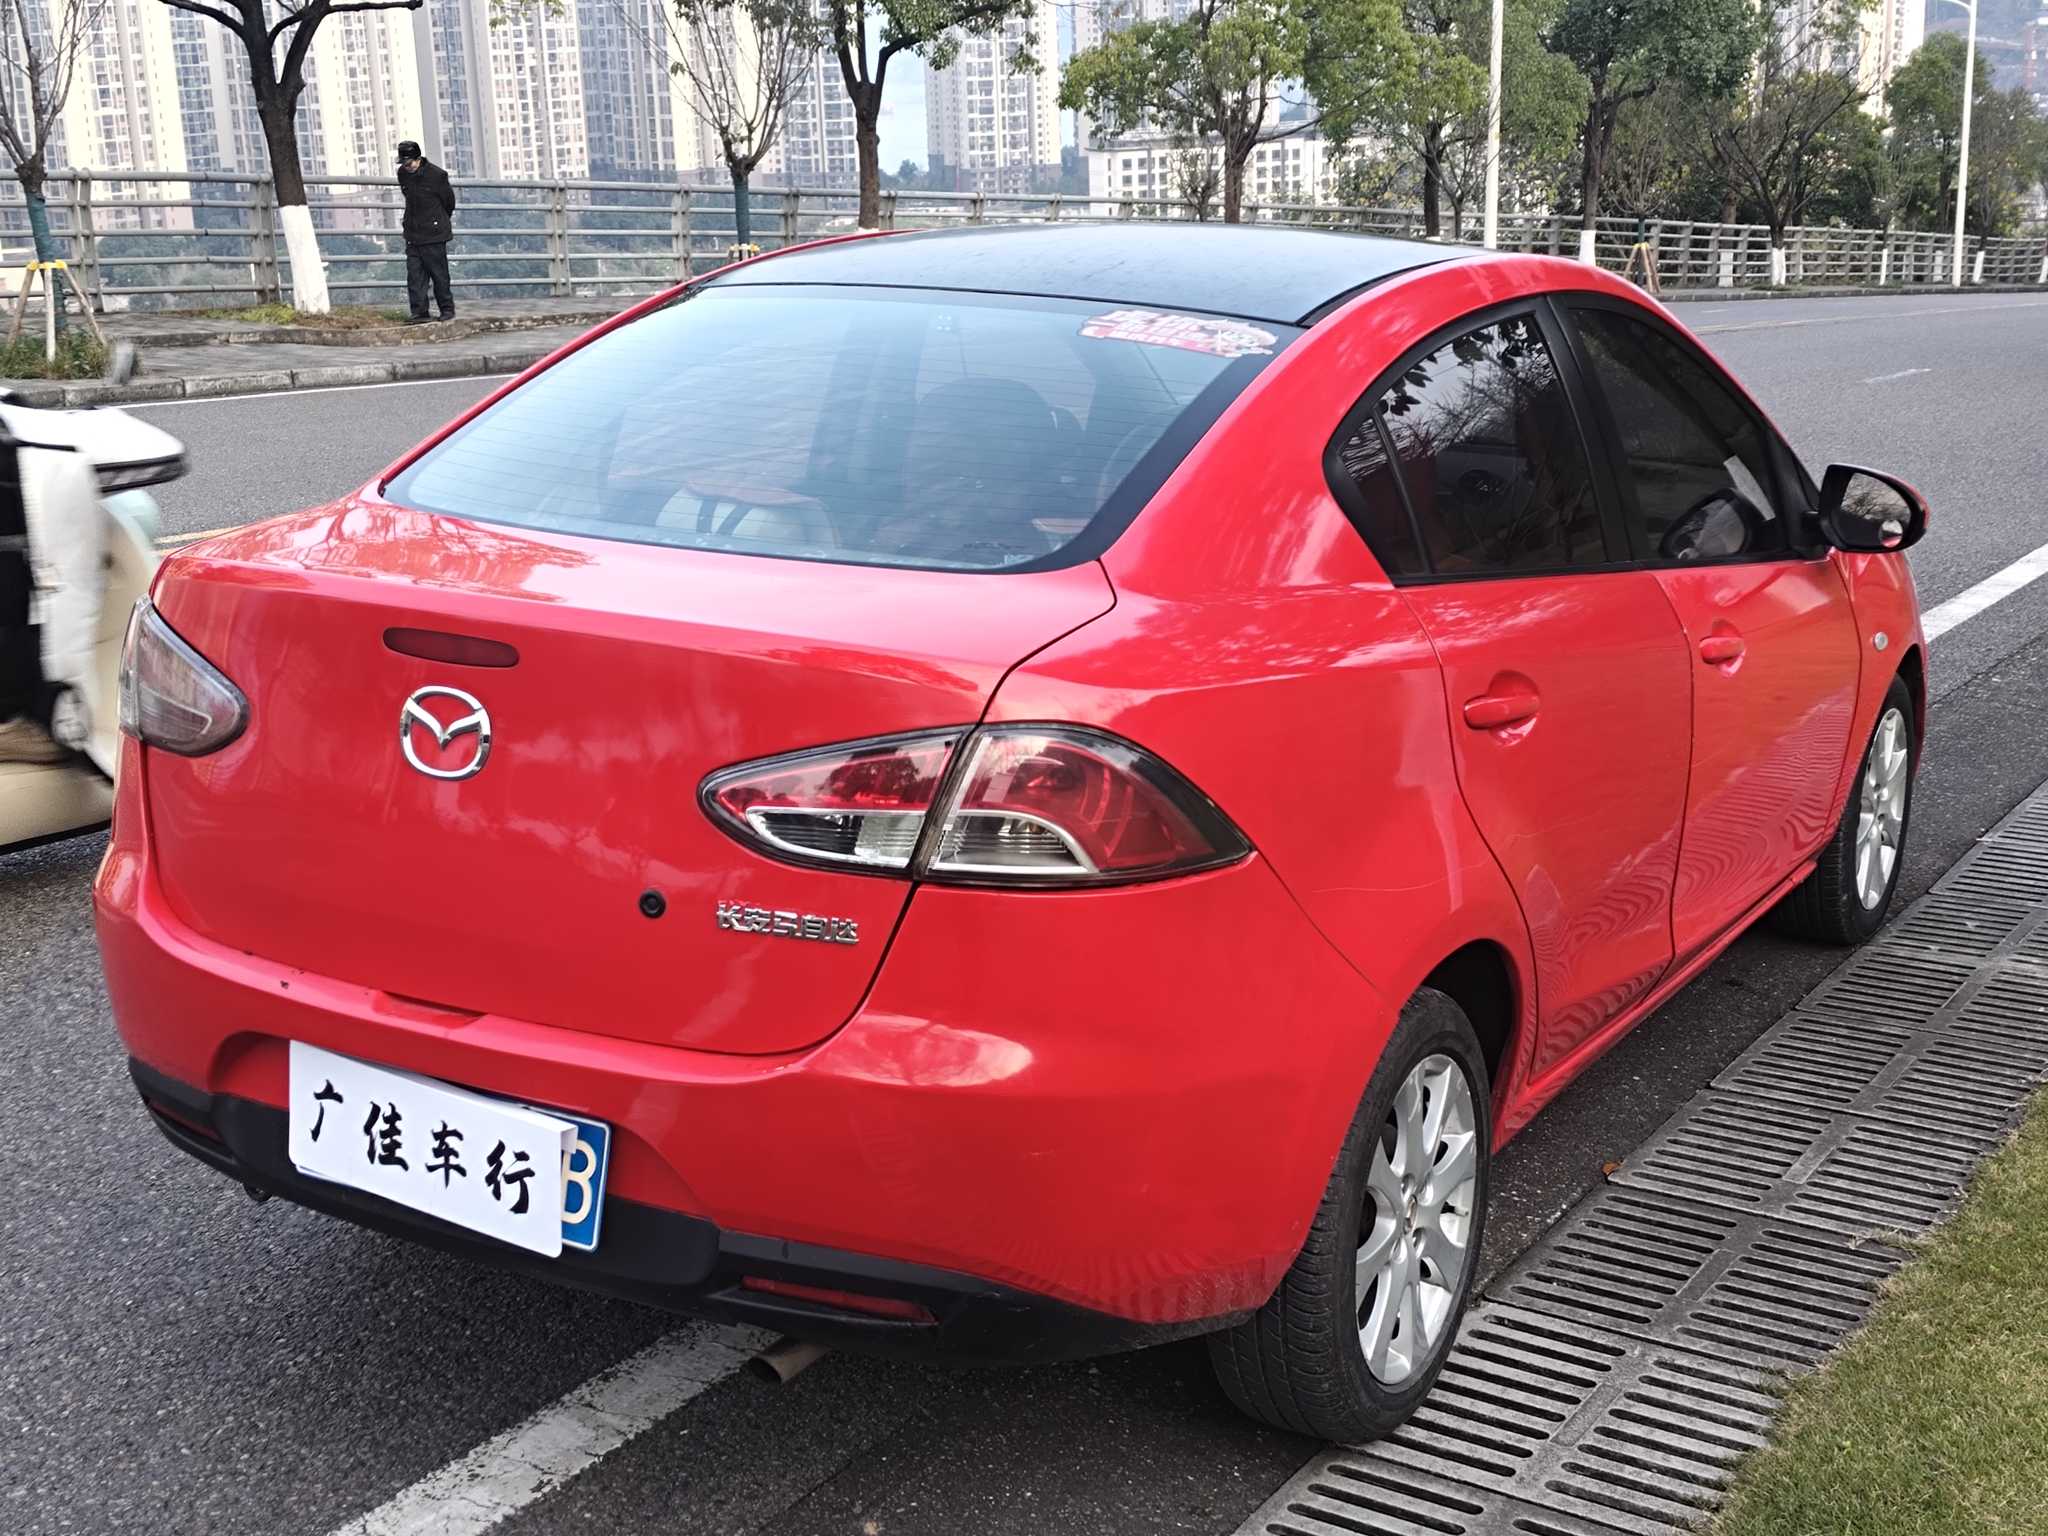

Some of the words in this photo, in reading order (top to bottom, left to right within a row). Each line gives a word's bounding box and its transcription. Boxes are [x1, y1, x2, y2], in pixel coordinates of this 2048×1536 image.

[717, 903, 860, 944] 长安马自达
[309, 1079, 536, 1214] 广佳车行
[561, 1139, 597, 1225] B
